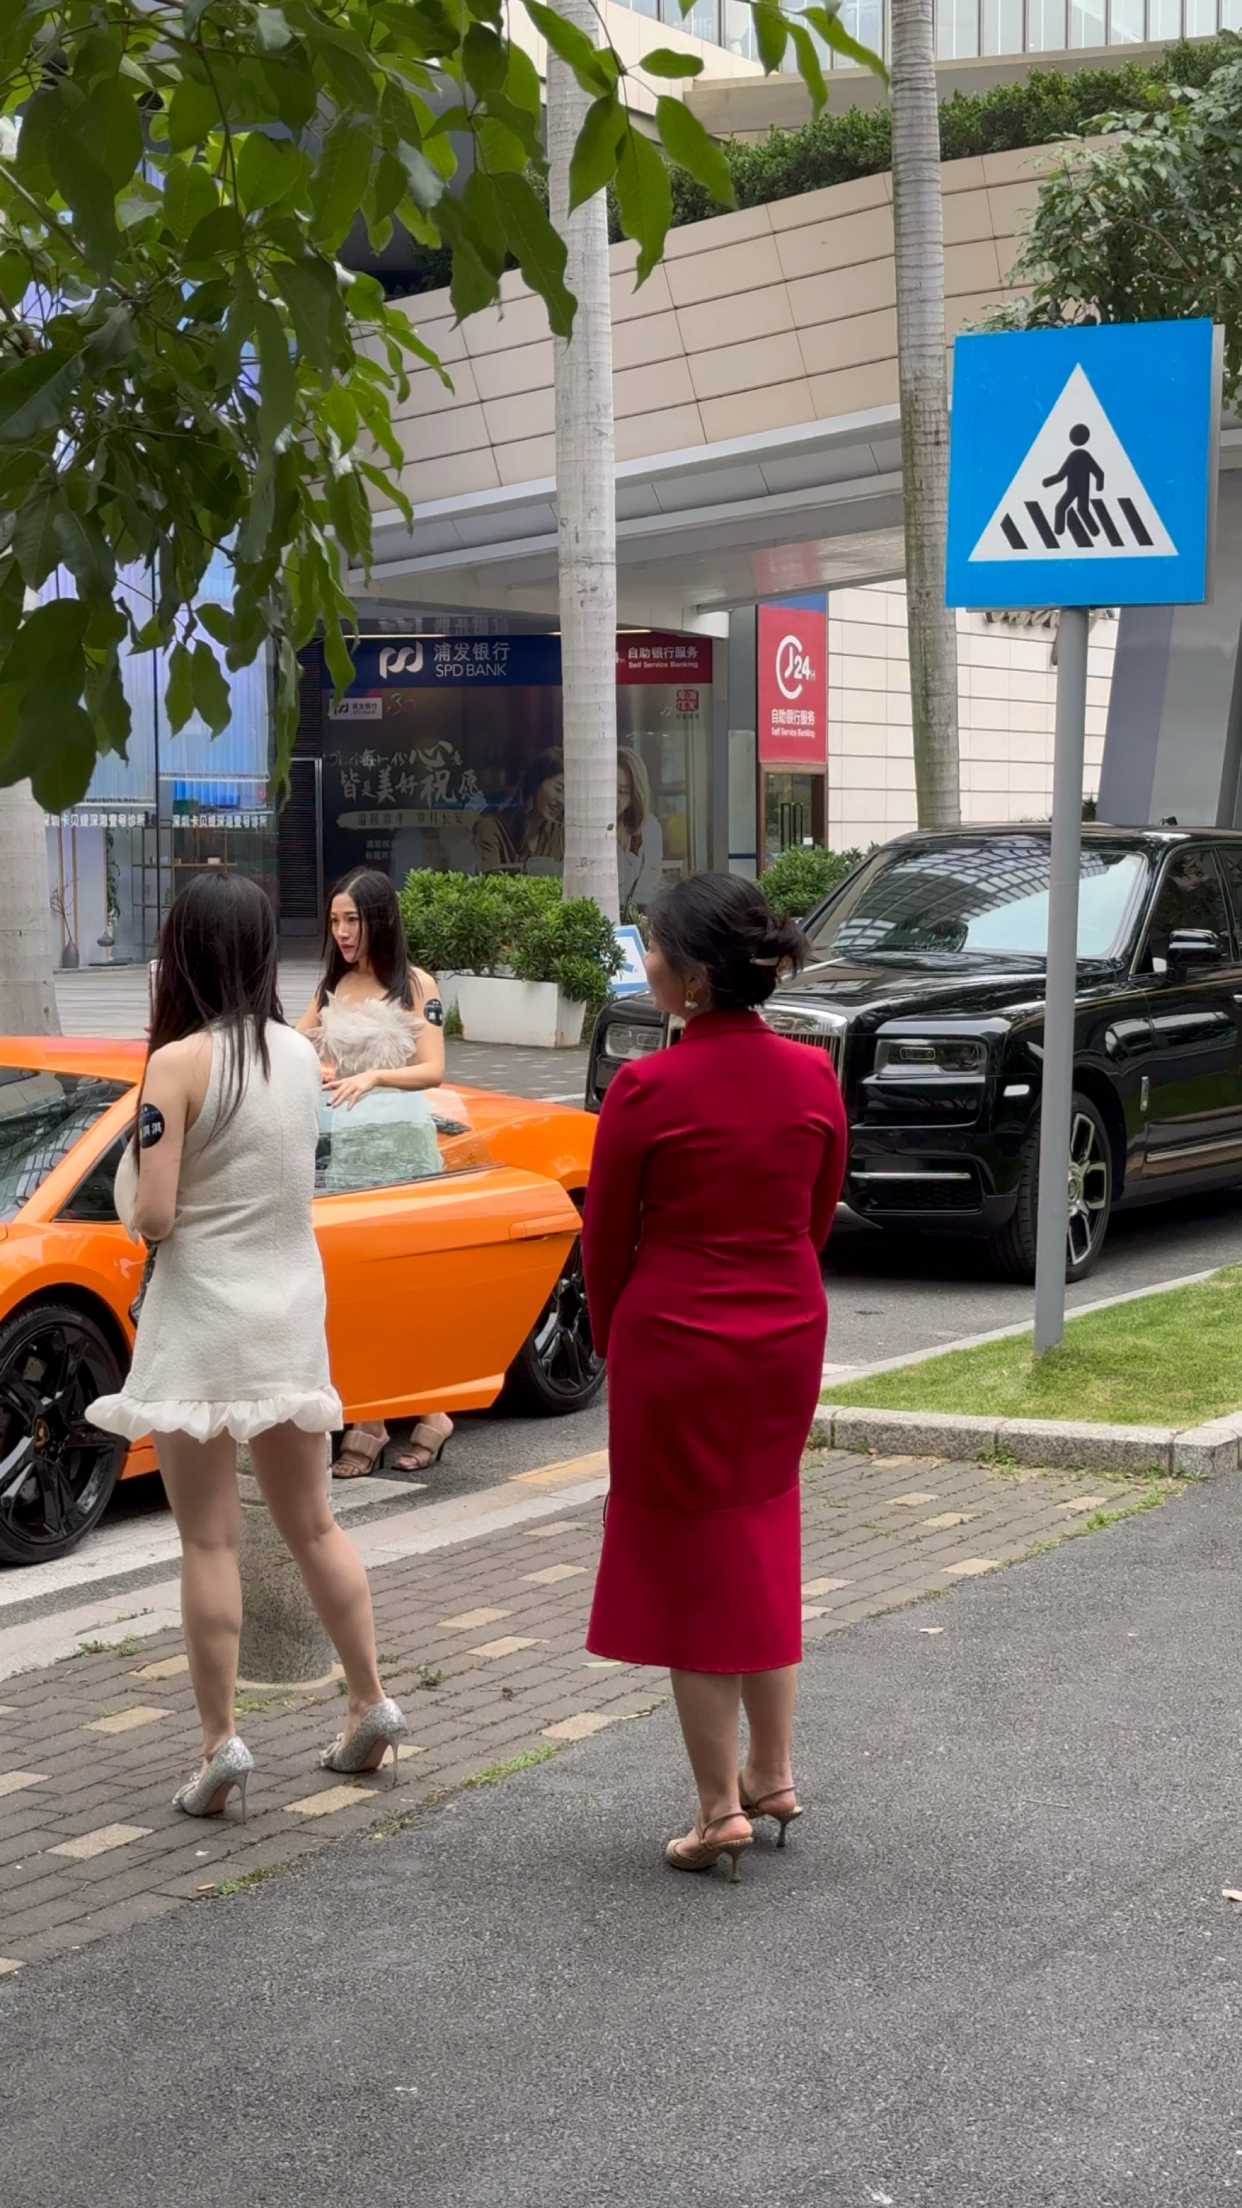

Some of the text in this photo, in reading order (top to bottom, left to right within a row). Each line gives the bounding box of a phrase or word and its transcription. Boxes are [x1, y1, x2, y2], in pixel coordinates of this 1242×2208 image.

[434, 642, 511, 661] 浦发银行
[628, 645, 698, 659] 自助银行服务
[436, 662, 507, 677] SPD BANK
[628, 660, 699, 669] Self Service Banking
[771, 707, 815, 726] 自助银行服务
